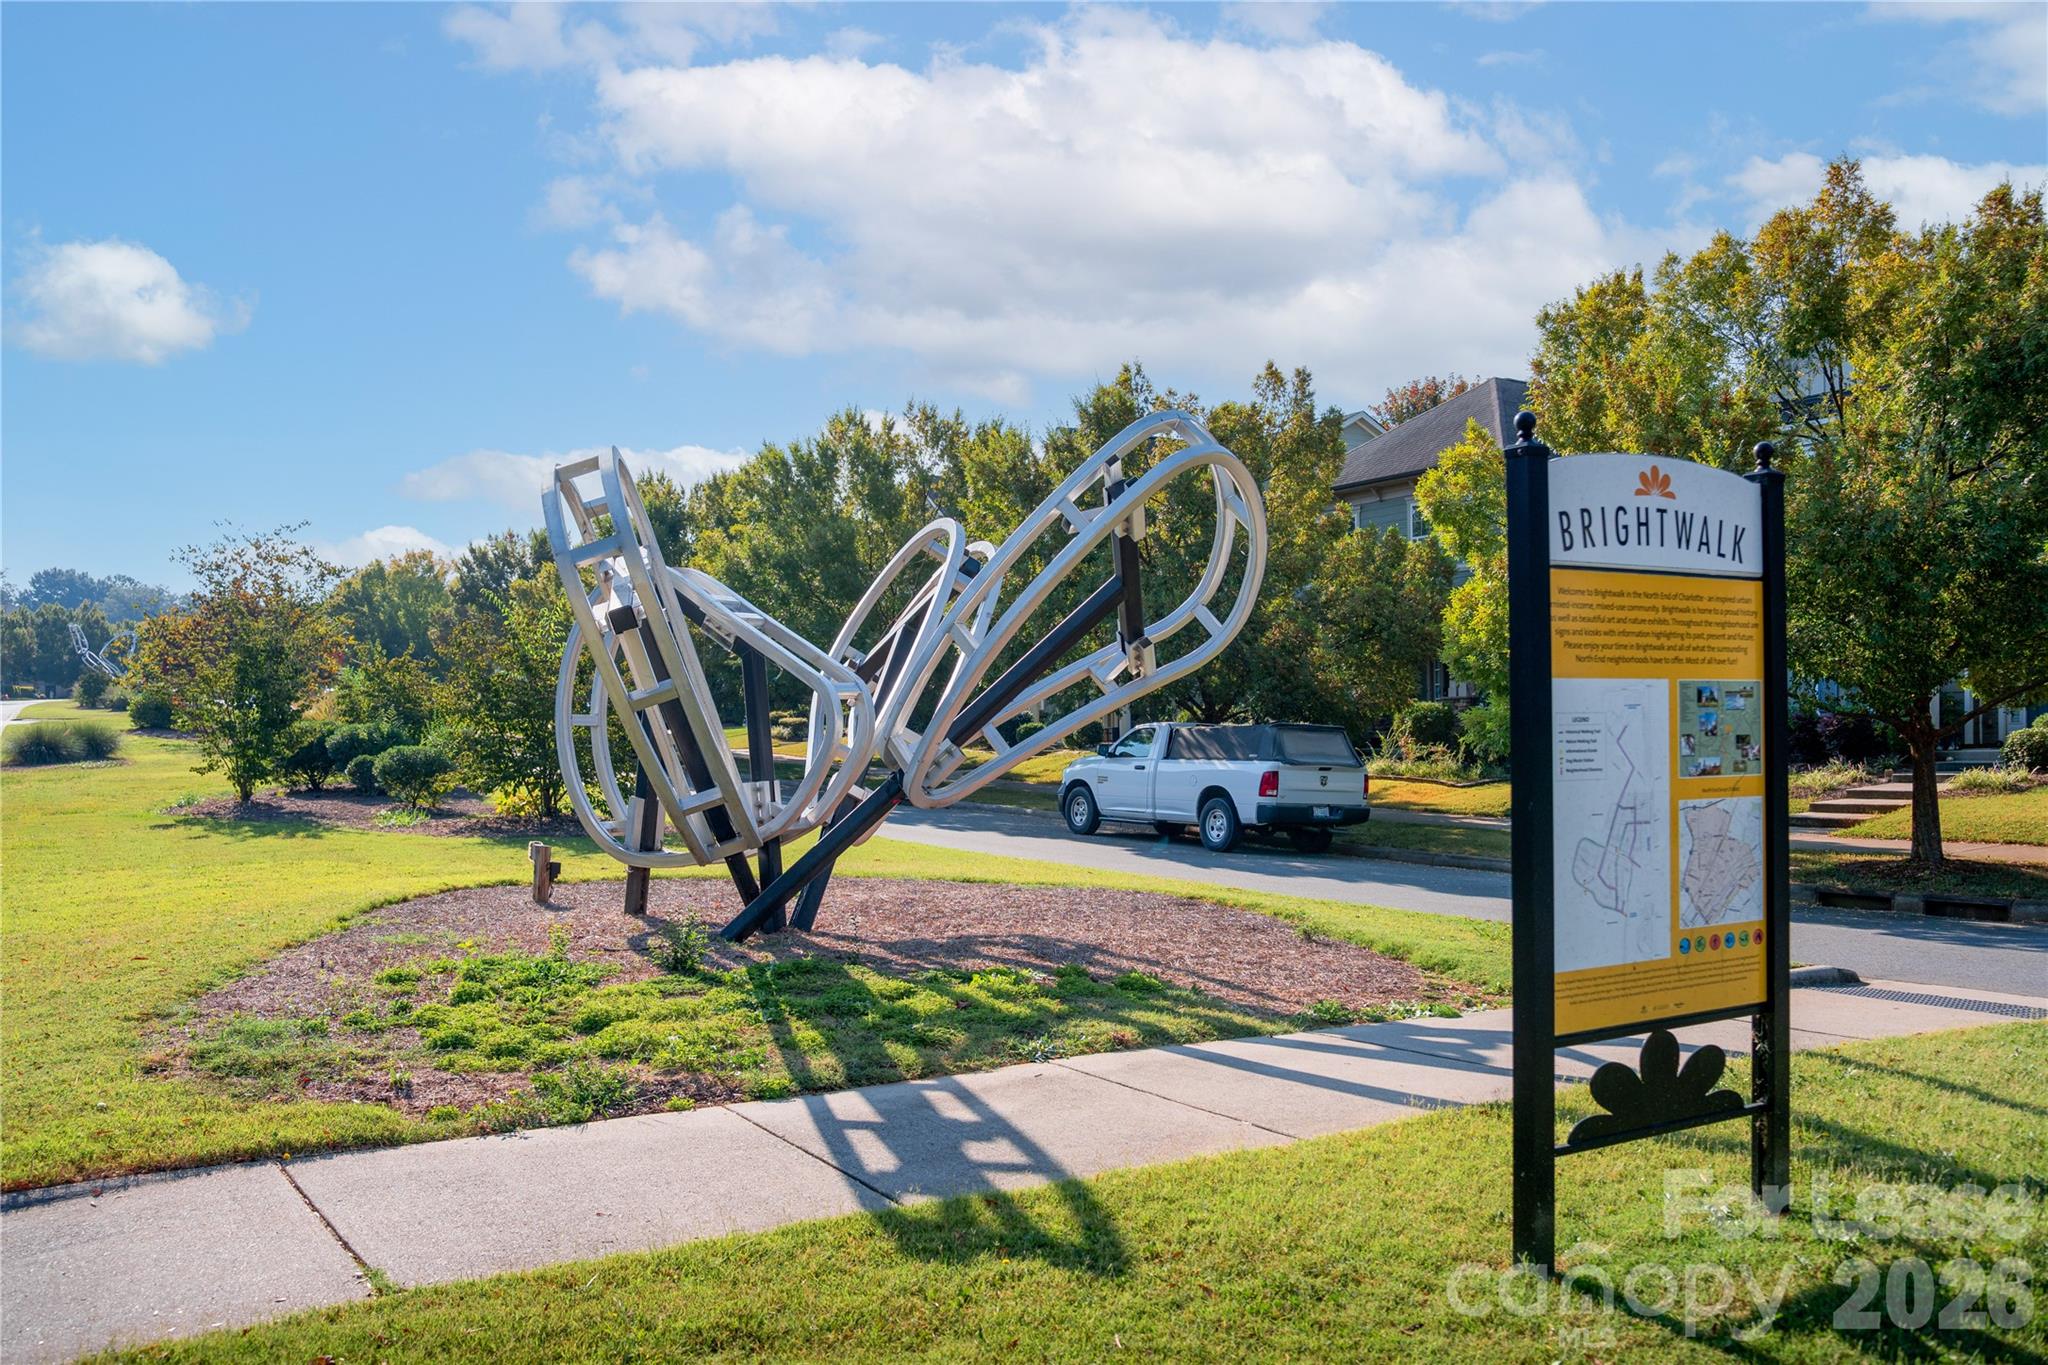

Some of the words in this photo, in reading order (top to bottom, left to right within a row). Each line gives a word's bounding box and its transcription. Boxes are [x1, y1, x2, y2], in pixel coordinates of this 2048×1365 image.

[1558, 506, 1746, 564] BRIGHTWALK
[1594, 588, 1624, 599] Brightwalk
[1643, 591, 1659, 599] North
[1660, 592, 1671, 600] End
[1662, 605, 1690, 615] Brightwalk
[1578, 615, 1605, 623] beautiful
[1616, 616, 1627, 624] and
[1617, 630, 1650, 638] information
[1563, 640, 1583, 650] Please
[1600, 643, 1614, 652] your
[1614, 642, 1628, 651] time
[1636, 643, 1664, 654] Brightwalk
[1666, 644, 1677, 652] and
[1692, 645, 1706, 653] what
[1575, 654, 1593, 663] North
[1594, 654, 1606, 664] End
[1606, 656, 1649, 666] neighborhoods
[1650, 657, 1664, 665] have
